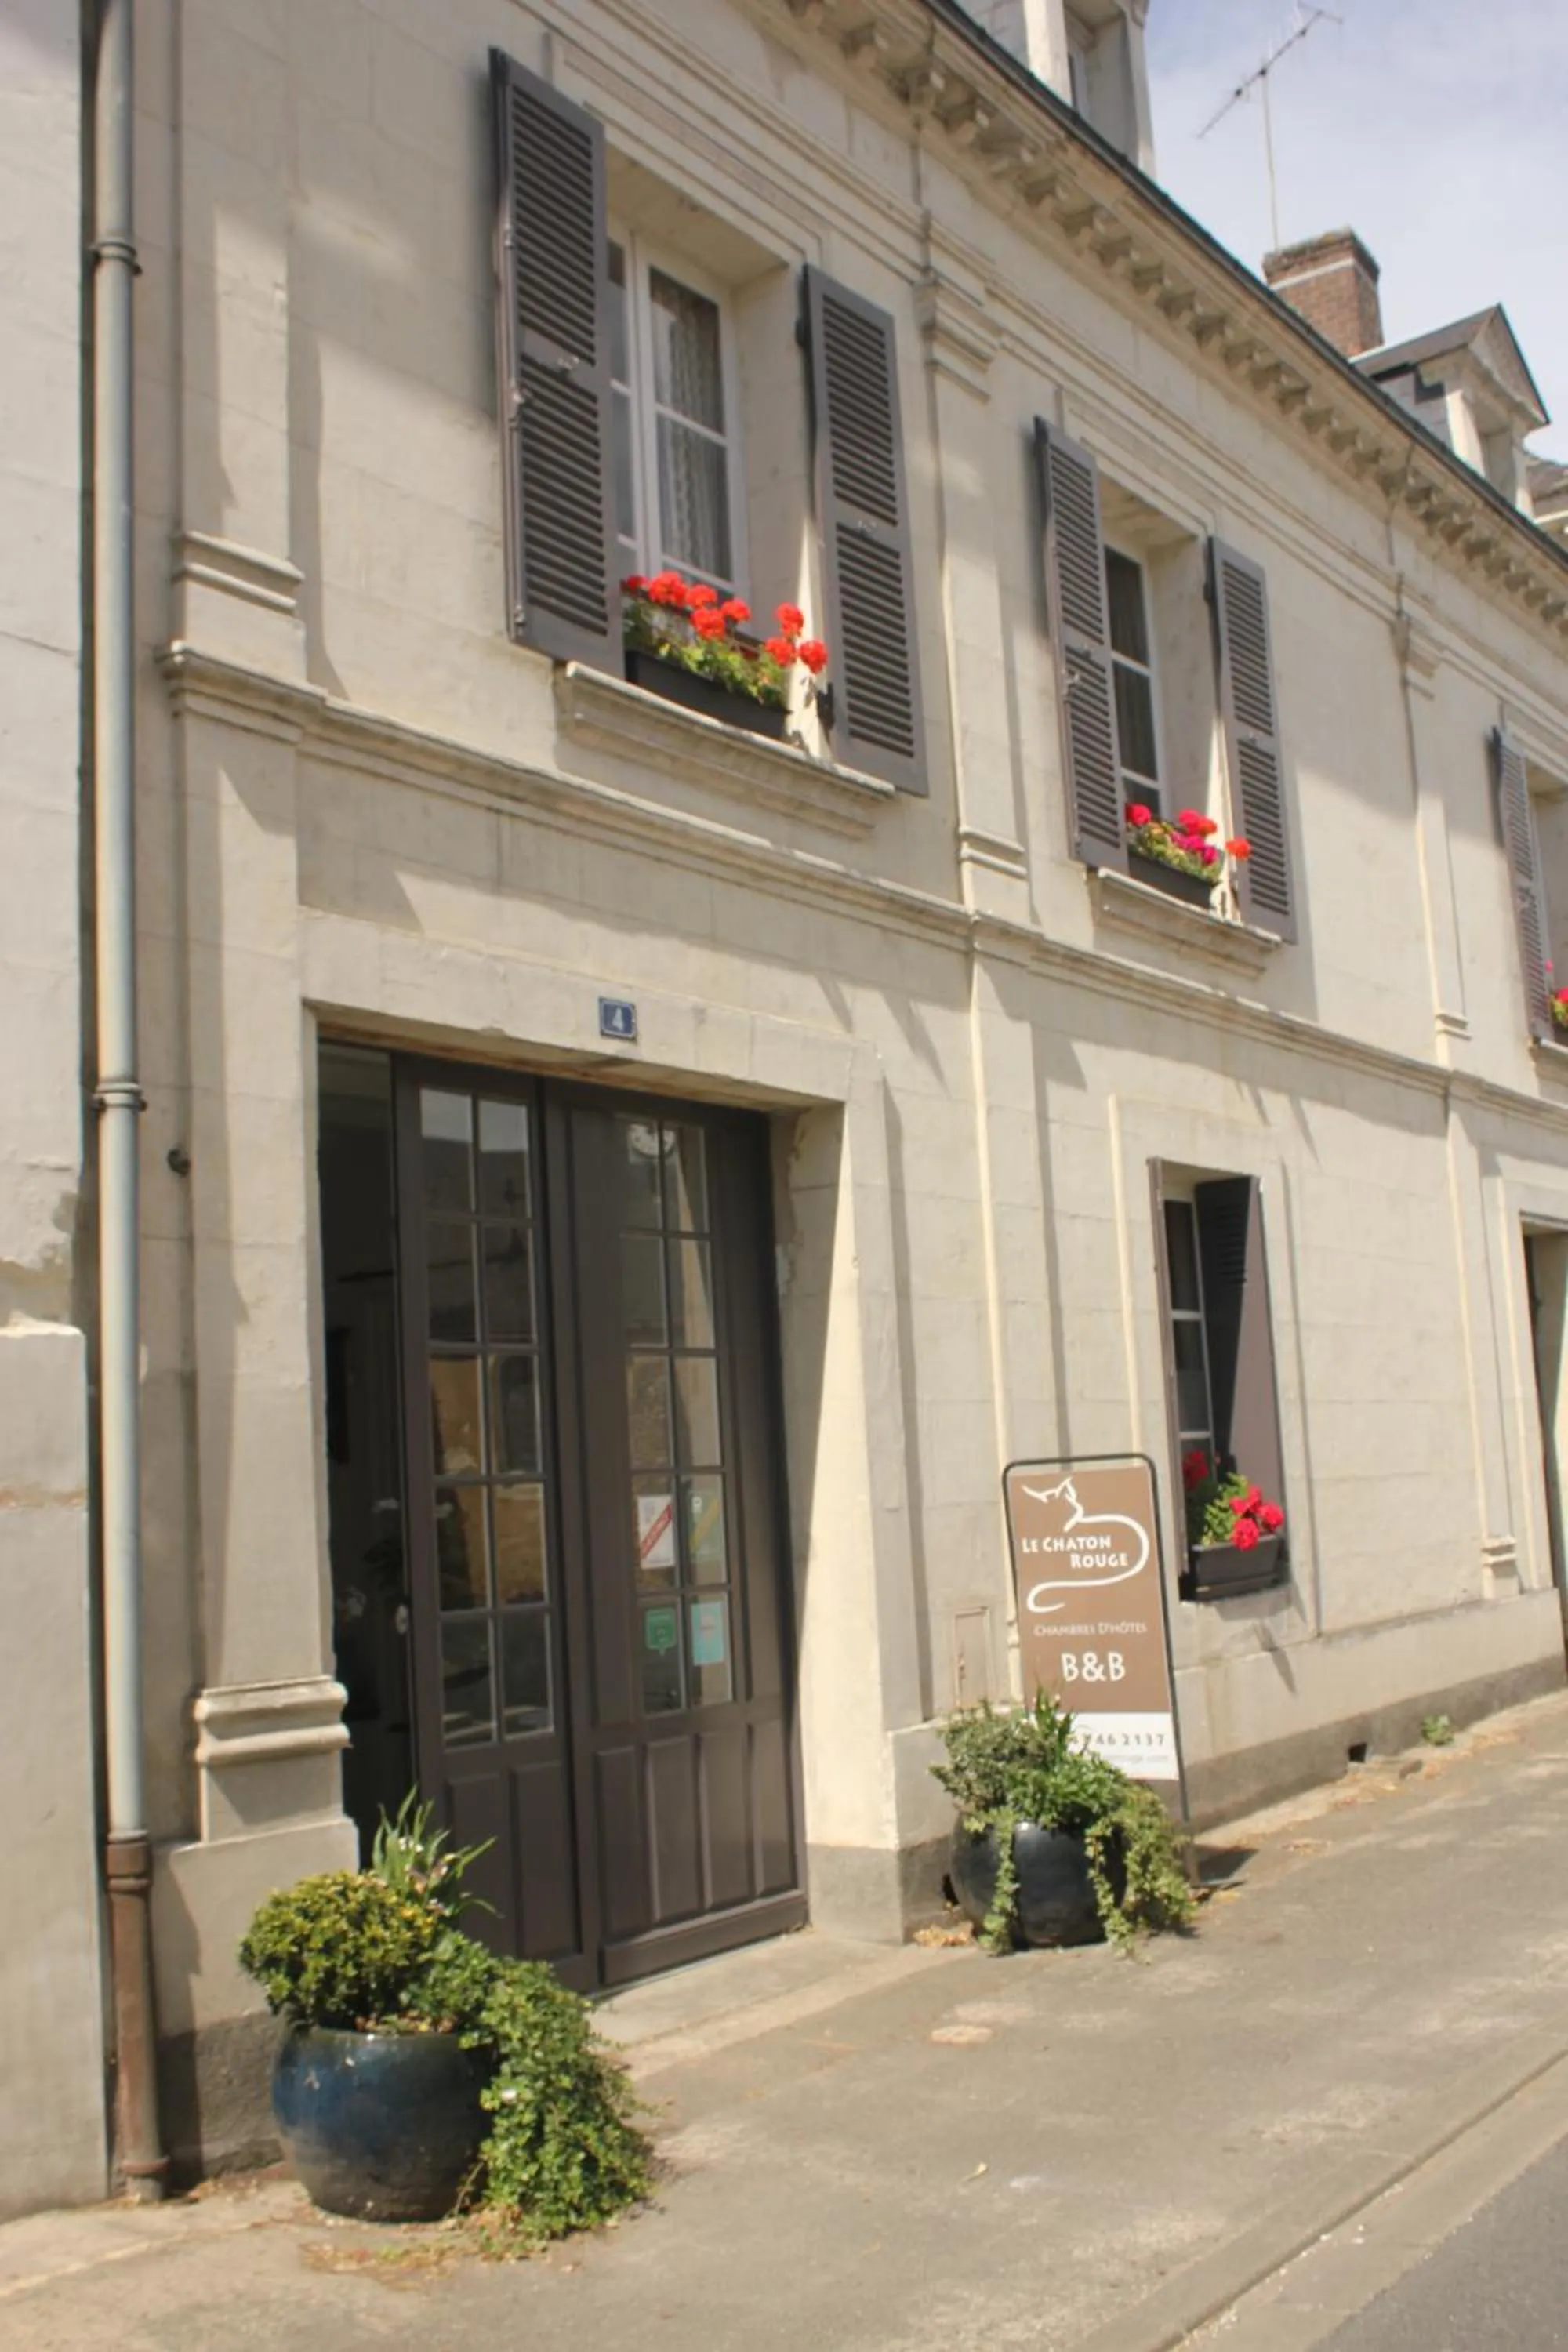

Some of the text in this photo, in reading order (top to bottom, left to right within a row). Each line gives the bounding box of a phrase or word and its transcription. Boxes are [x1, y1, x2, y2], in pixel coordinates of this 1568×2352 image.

[612, 1006, 625, 1032] 4
[1022, 1534, 1112, 1553] LE CHATON
[1070, 1552, 1129, 1569] ROUGE
[1033, 1623, 1096, 1636] CHAMBRES
[1061, 1650, 1126, 1682] B&B
